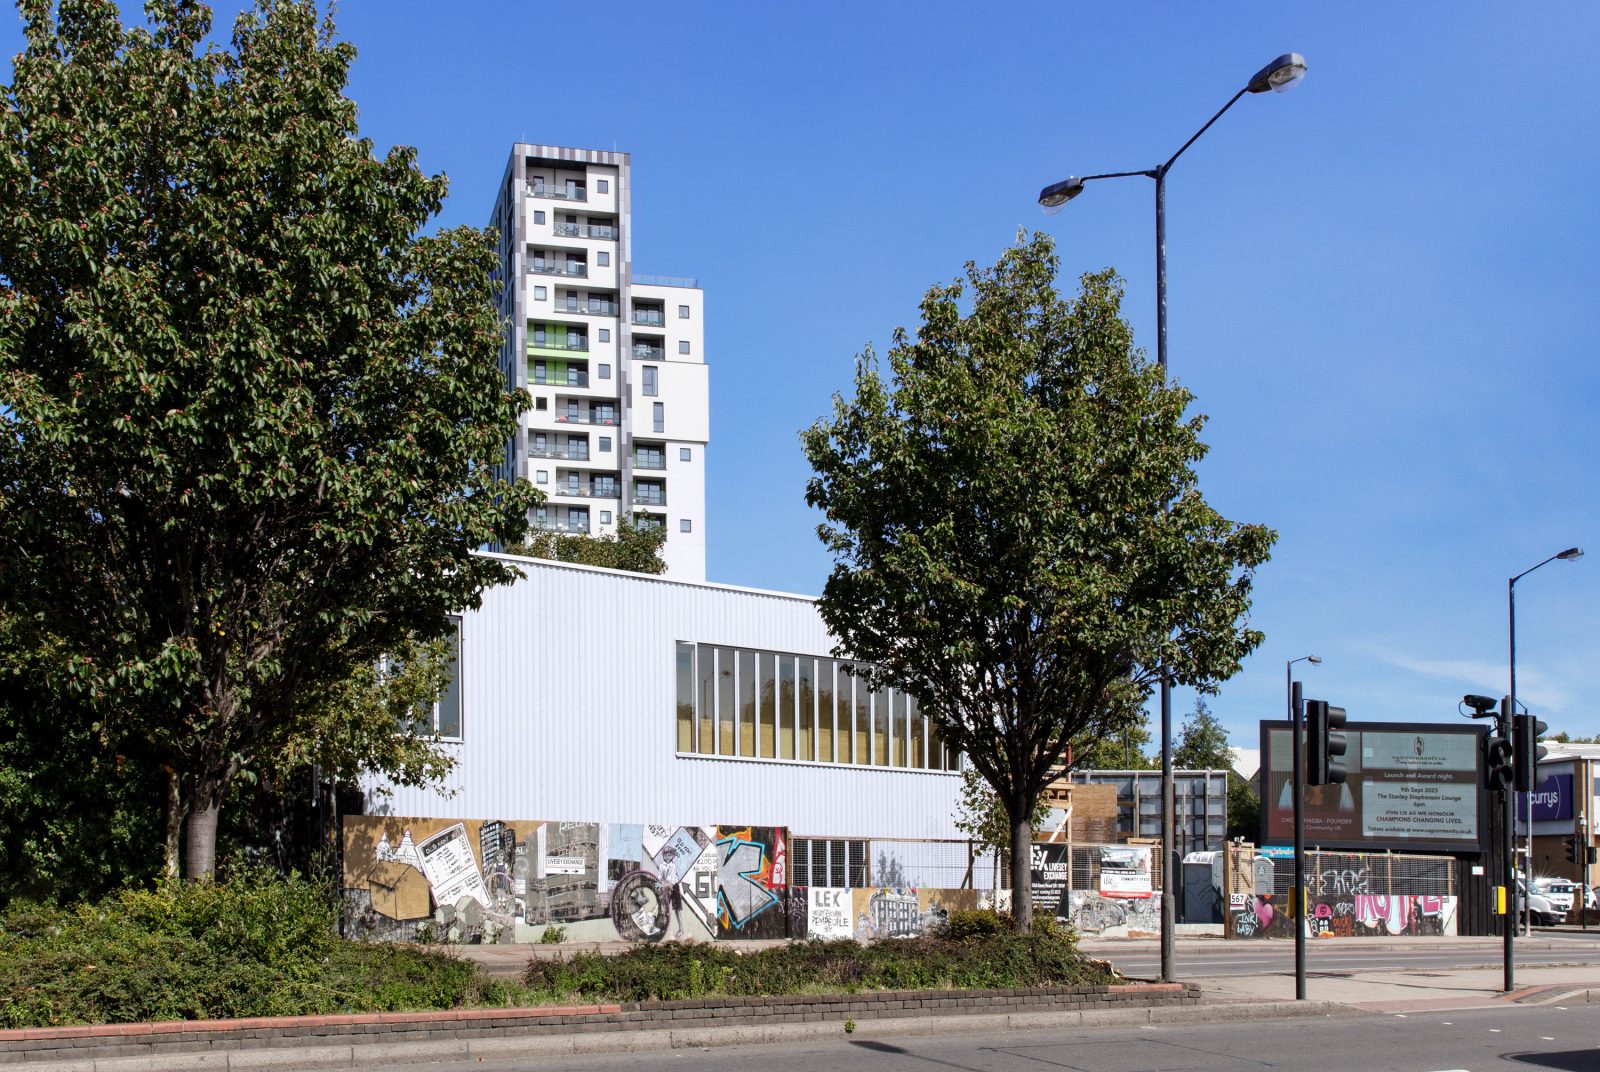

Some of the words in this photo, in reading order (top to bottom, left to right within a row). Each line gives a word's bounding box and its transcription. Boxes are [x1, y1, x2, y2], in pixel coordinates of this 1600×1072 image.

[1530, 791, 1558, 808] currys
[1048, 862, 1067, 871] LIVESEY
[1043, 871, 1067, 880] EXCHANGE
[815, 891, 840, 907] LEX
[1231, 895, 1244, 903] 567
